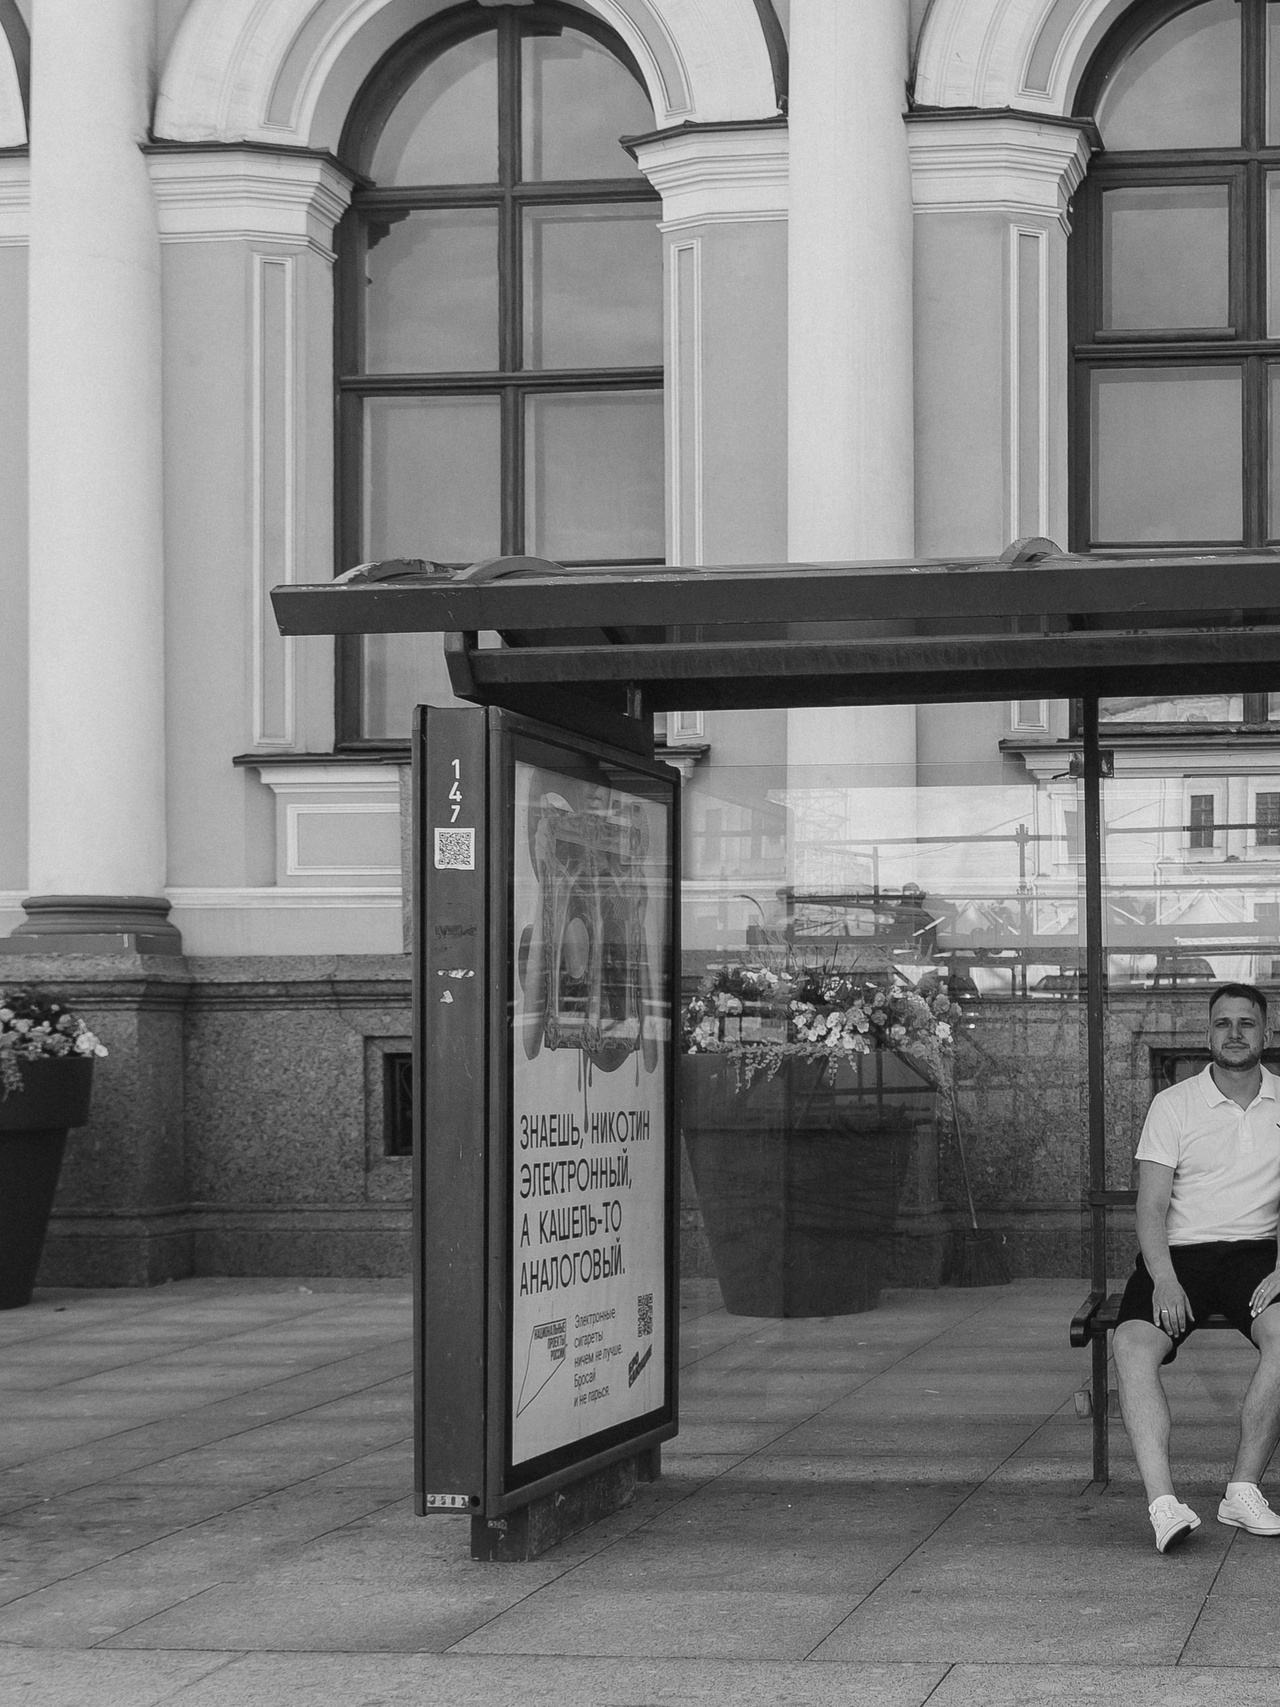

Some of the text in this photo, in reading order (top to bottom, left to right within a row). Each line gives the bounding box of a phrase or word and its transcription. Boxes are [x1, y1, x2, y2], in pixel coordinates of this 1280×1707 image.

[448, 758, 463, 823] 147
[520, 1110, 650, 1150] ЗНАЕШЬ, НИКОТИН
[519, 1147, 633, 1199] ЭЛЕКТРОННЫЙ,
[520, 1200, 623, 1248] А КАШЕЛЬ-ТО
[519, 1236, 626, 1297] АНАЛОГОВЫЙ.
[574, 1308, 616, 1329] Электронные
[574, 1330, 604, 1348] сигареты
[574, 1353, 594, 1368] ничем
[595, 1350, 602, 1361] не
[574, 1367, 596, 1390] Бросай
[580, 1393, 587, 1405] не
